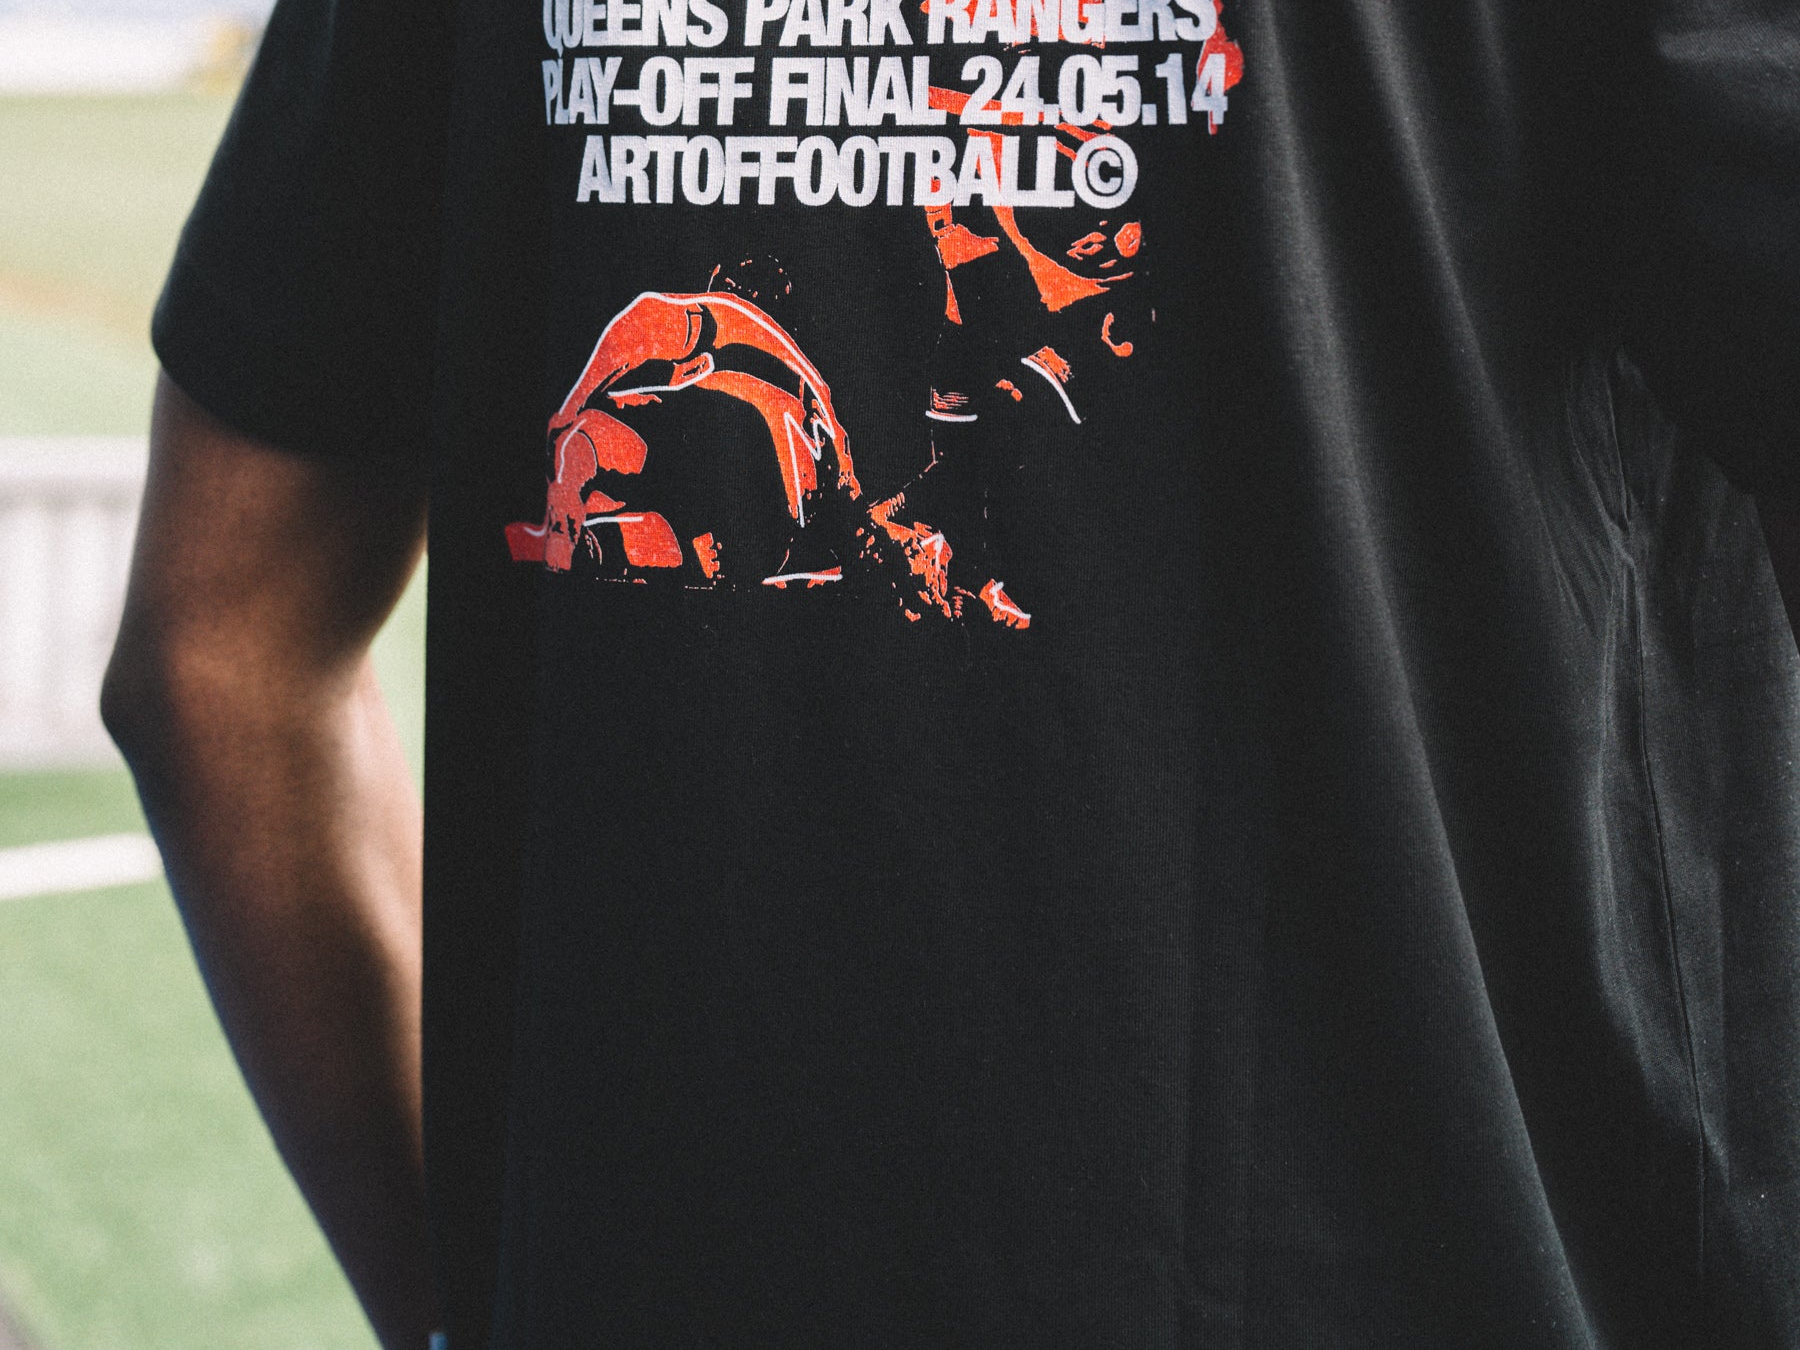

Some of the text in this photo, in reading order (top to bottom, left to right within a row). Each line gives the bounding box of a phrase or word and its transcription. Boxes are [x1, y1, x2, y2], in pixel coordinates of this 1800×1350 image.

[542, 53, 1228, 125] PLAY-OFF FINAL 24.05.14
